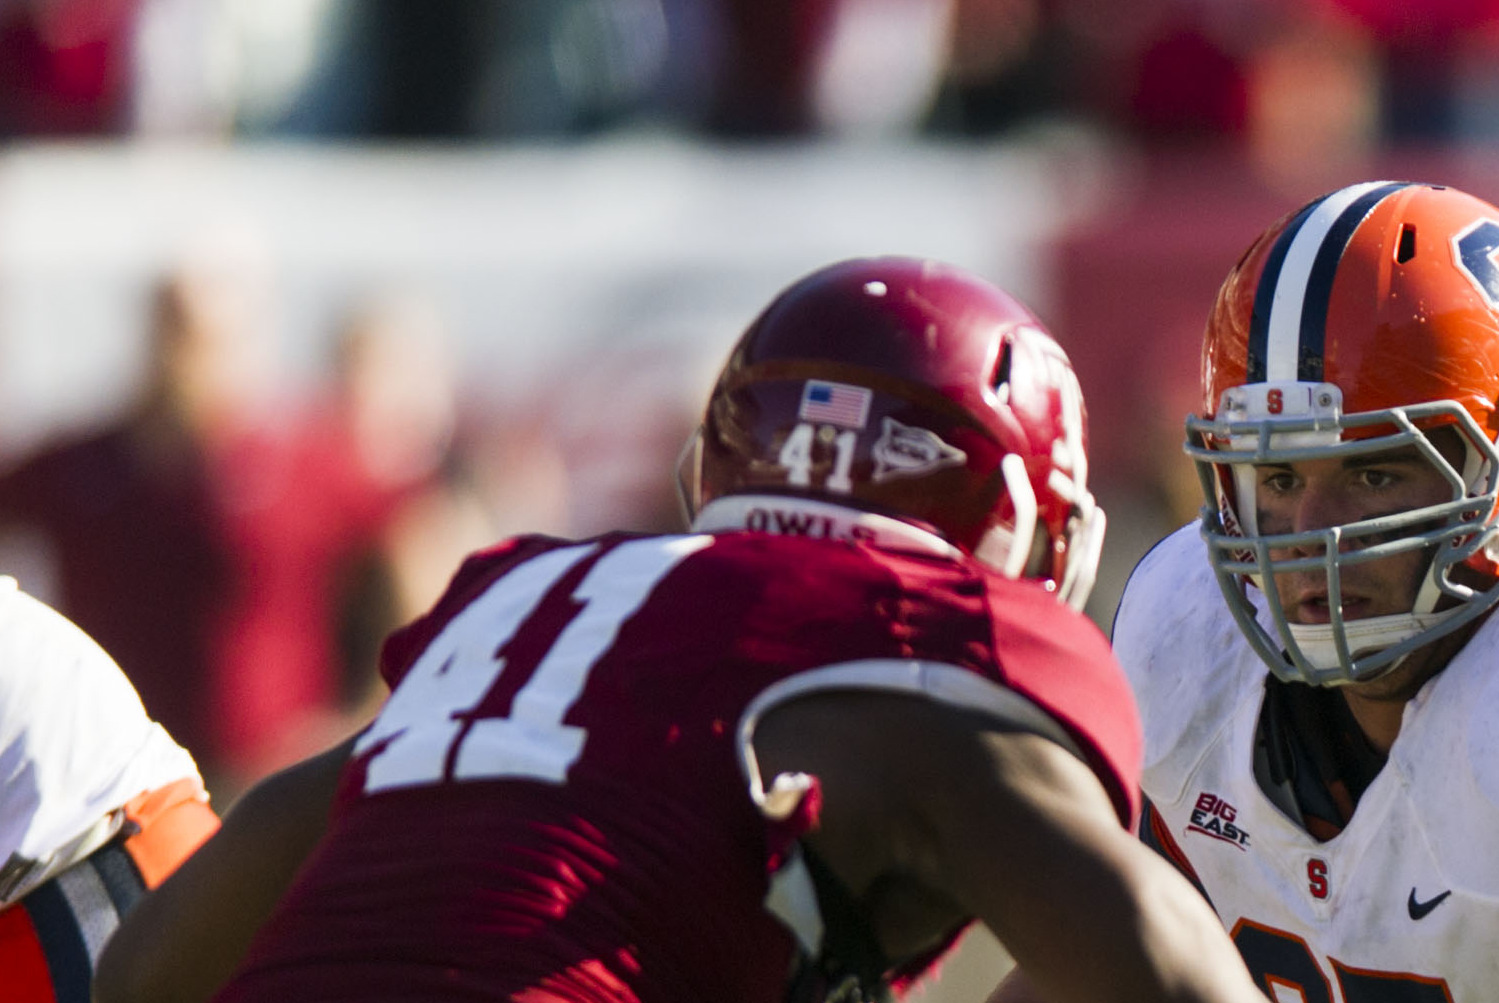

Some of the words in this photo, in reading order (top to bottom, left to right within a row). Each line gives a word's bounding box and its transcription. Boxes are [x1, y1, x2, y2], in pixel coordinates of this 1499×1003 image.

[1267, 388, 1283, 415] S
[778, 424, 857, 492] 41
[352, 534, 716, 796] 41
[1190, 808, 1252, 845] EAST
[1195, 792, 1238, 823] BIG
[1306, 858, 1329, 899] S
